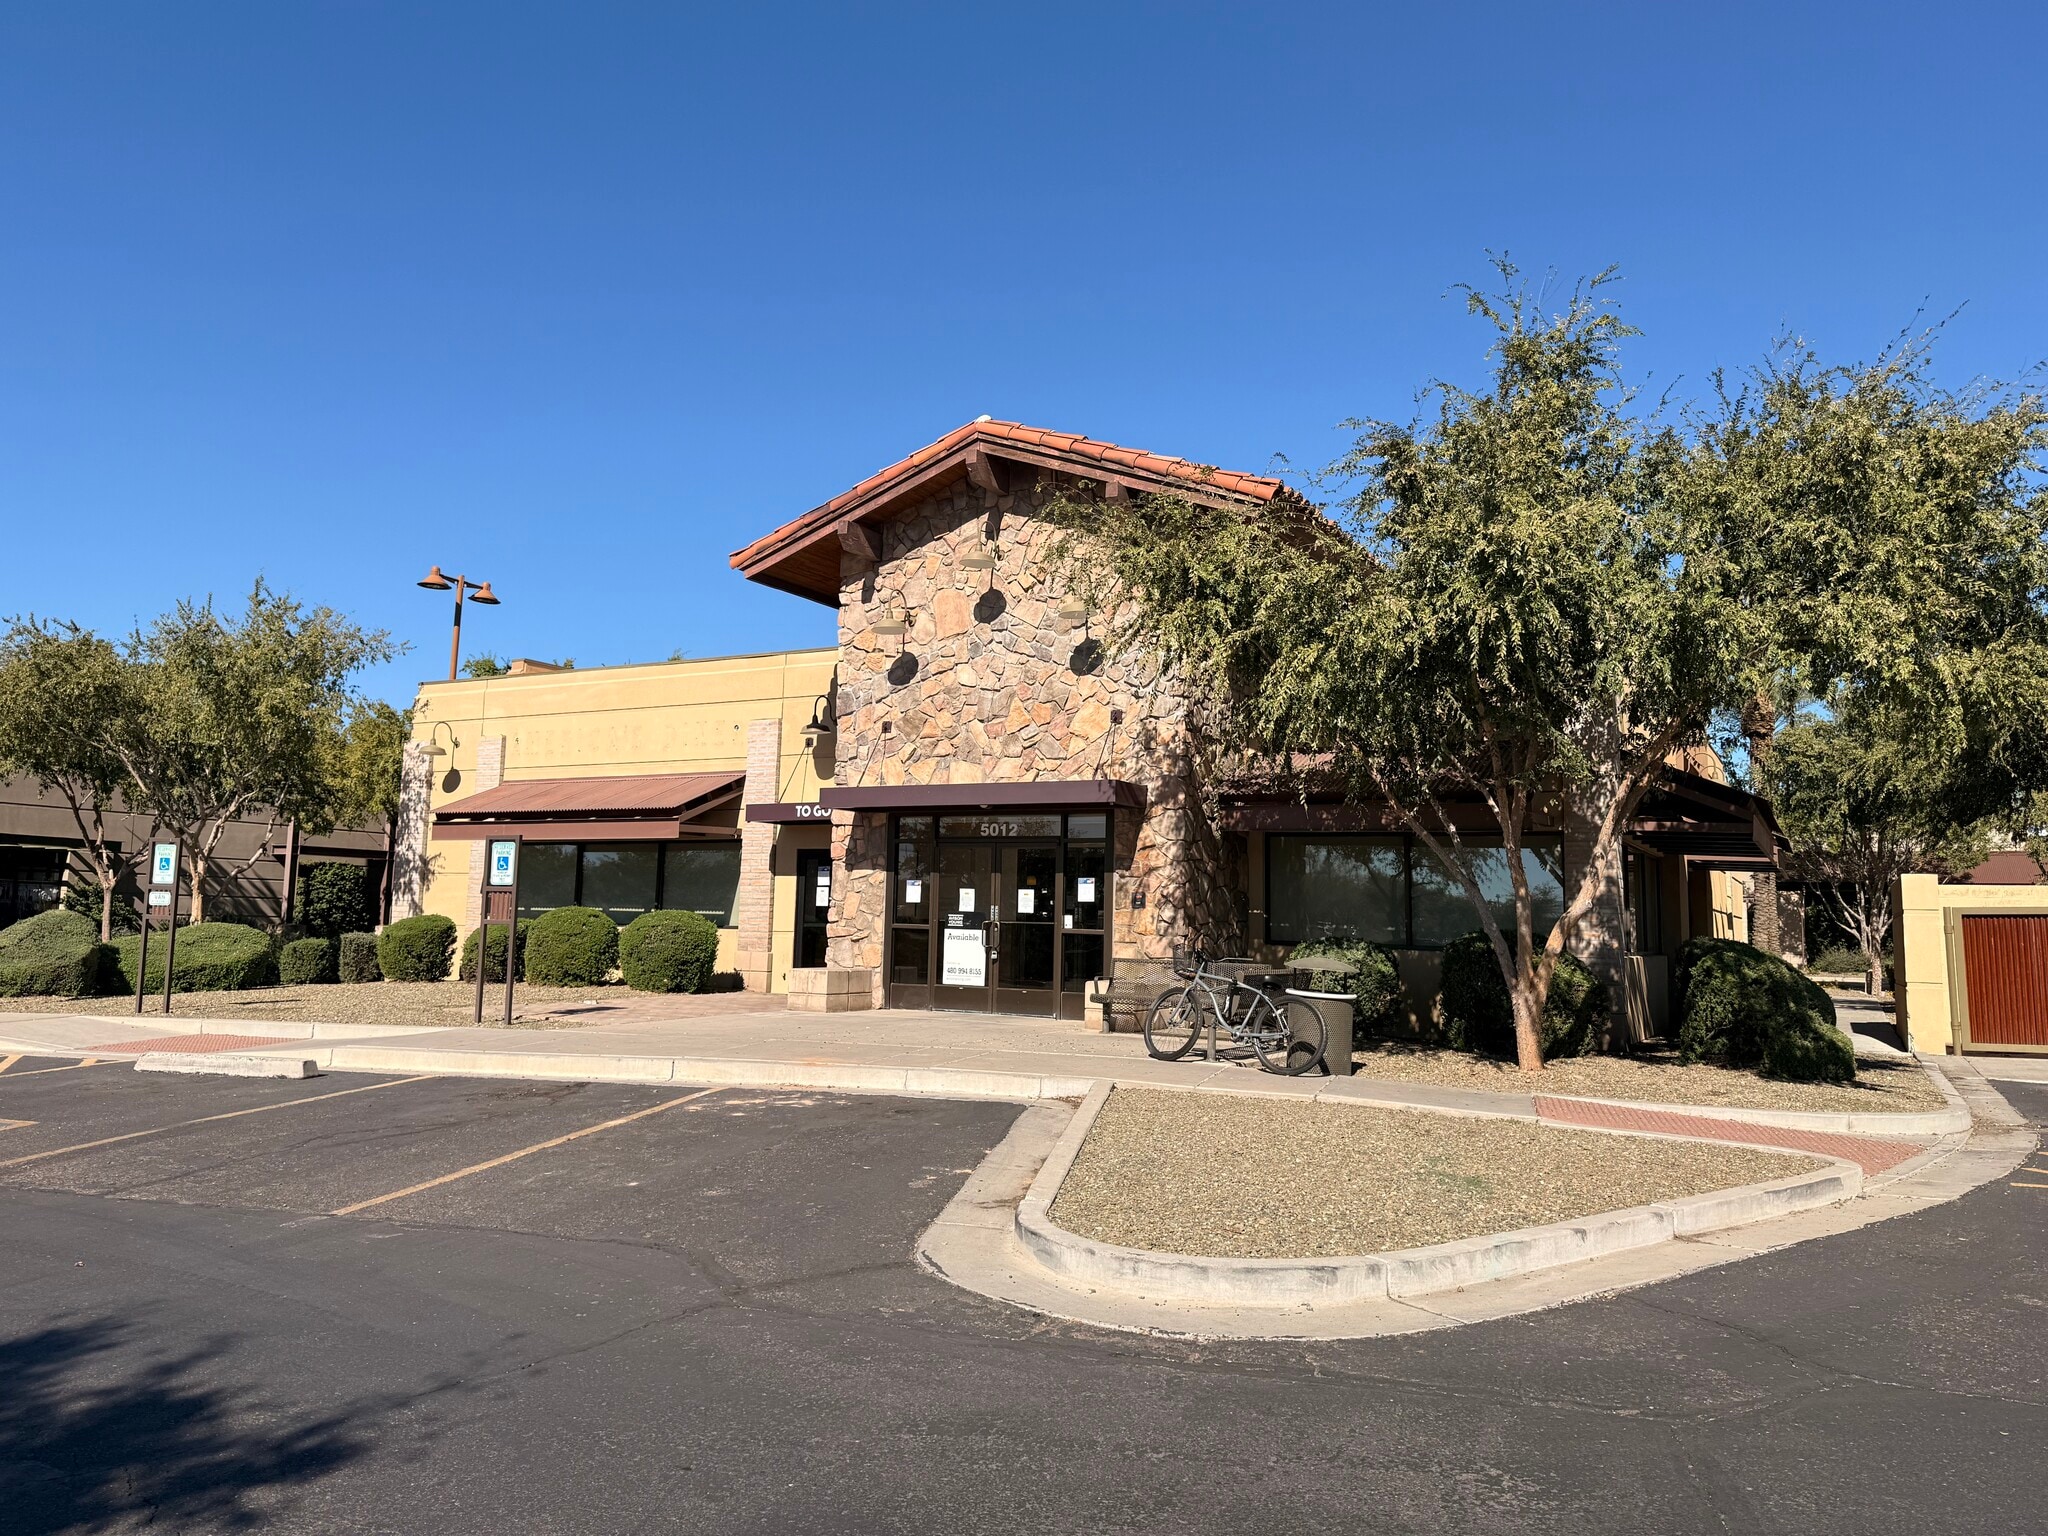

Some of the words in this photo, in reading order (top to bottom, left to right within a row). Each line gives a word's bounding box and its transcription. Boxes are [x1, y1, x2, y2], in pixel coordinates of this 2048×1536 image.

[795, 805, 811, 818] TO
[813, 804, 832, 817] GO
[980, 823, 1018, 837] 5012
[947, 933, 980, 942] Available
